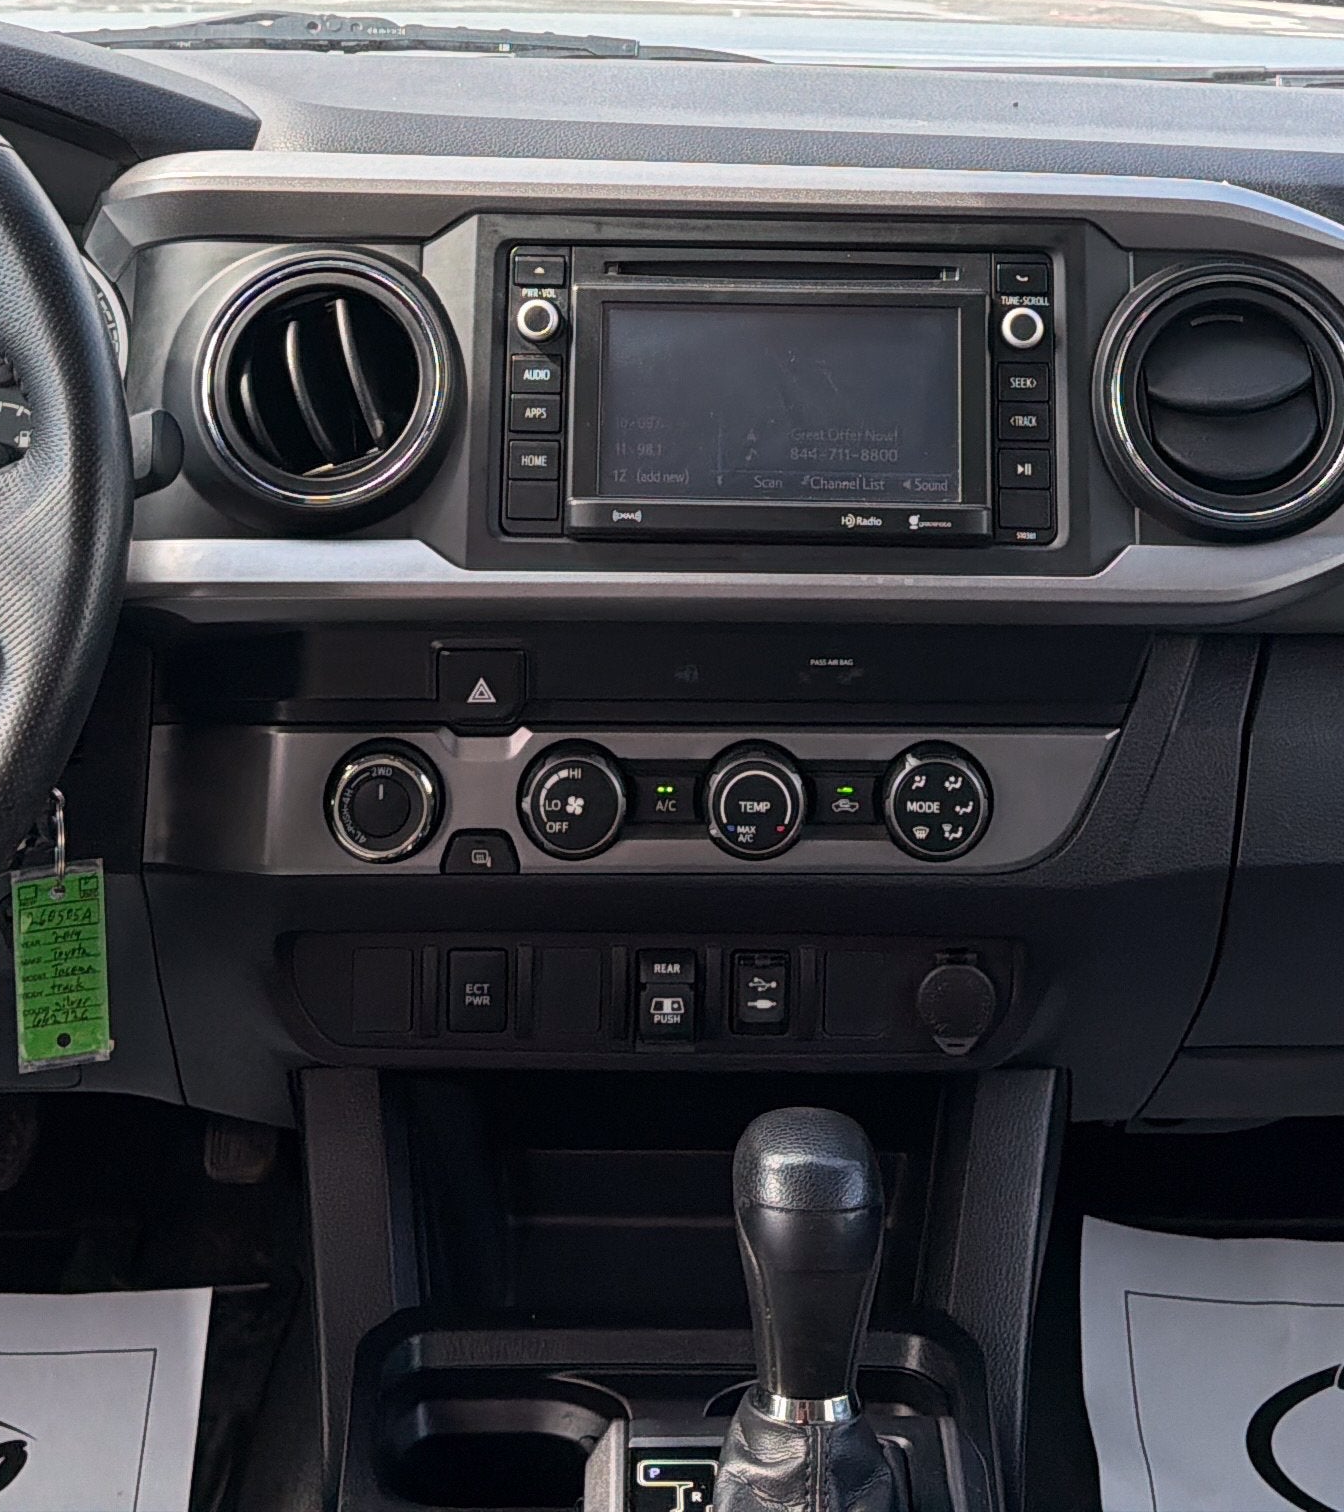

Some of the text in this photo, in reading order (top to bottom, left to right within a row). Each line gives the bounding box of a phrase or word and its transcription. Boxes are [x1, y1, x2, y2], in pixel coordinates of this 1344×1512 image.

[523, 370, 550, 381] AUDIO
[525, 408, 547, 419] APPS
[521, 455, 547, 466] HOME
[790, 448, 898, 462] 844-711-8800
[613, 469, 689, 483] 12 (add new)
[754, 476, 948, 492] Scan Channel List Sound
[857, 517, 882, 527] Radio
[371, 767, 393, 777] 2WD
[569, 768, 582, 780] HI
[545, 800, 561, 811] LO
[656, 800, 676, 812] A/C
[739, 801, 770, 813] TEMP
[906, 801, 941, 814] MODE
[546, 821, 569, 834] OFF
[737, 825, 756, 834] MAX
[738, 834, 754, 843] A/C
[654, 963, 681, 973] REAR
[466, 985, 489, 995] ECT
[465, 996, 490, 1006] PWR
[654, 1013, 681, 1024] PUSH
[649, 1468, 660, 1478] P
[692, 1490, 703, 1502] R
